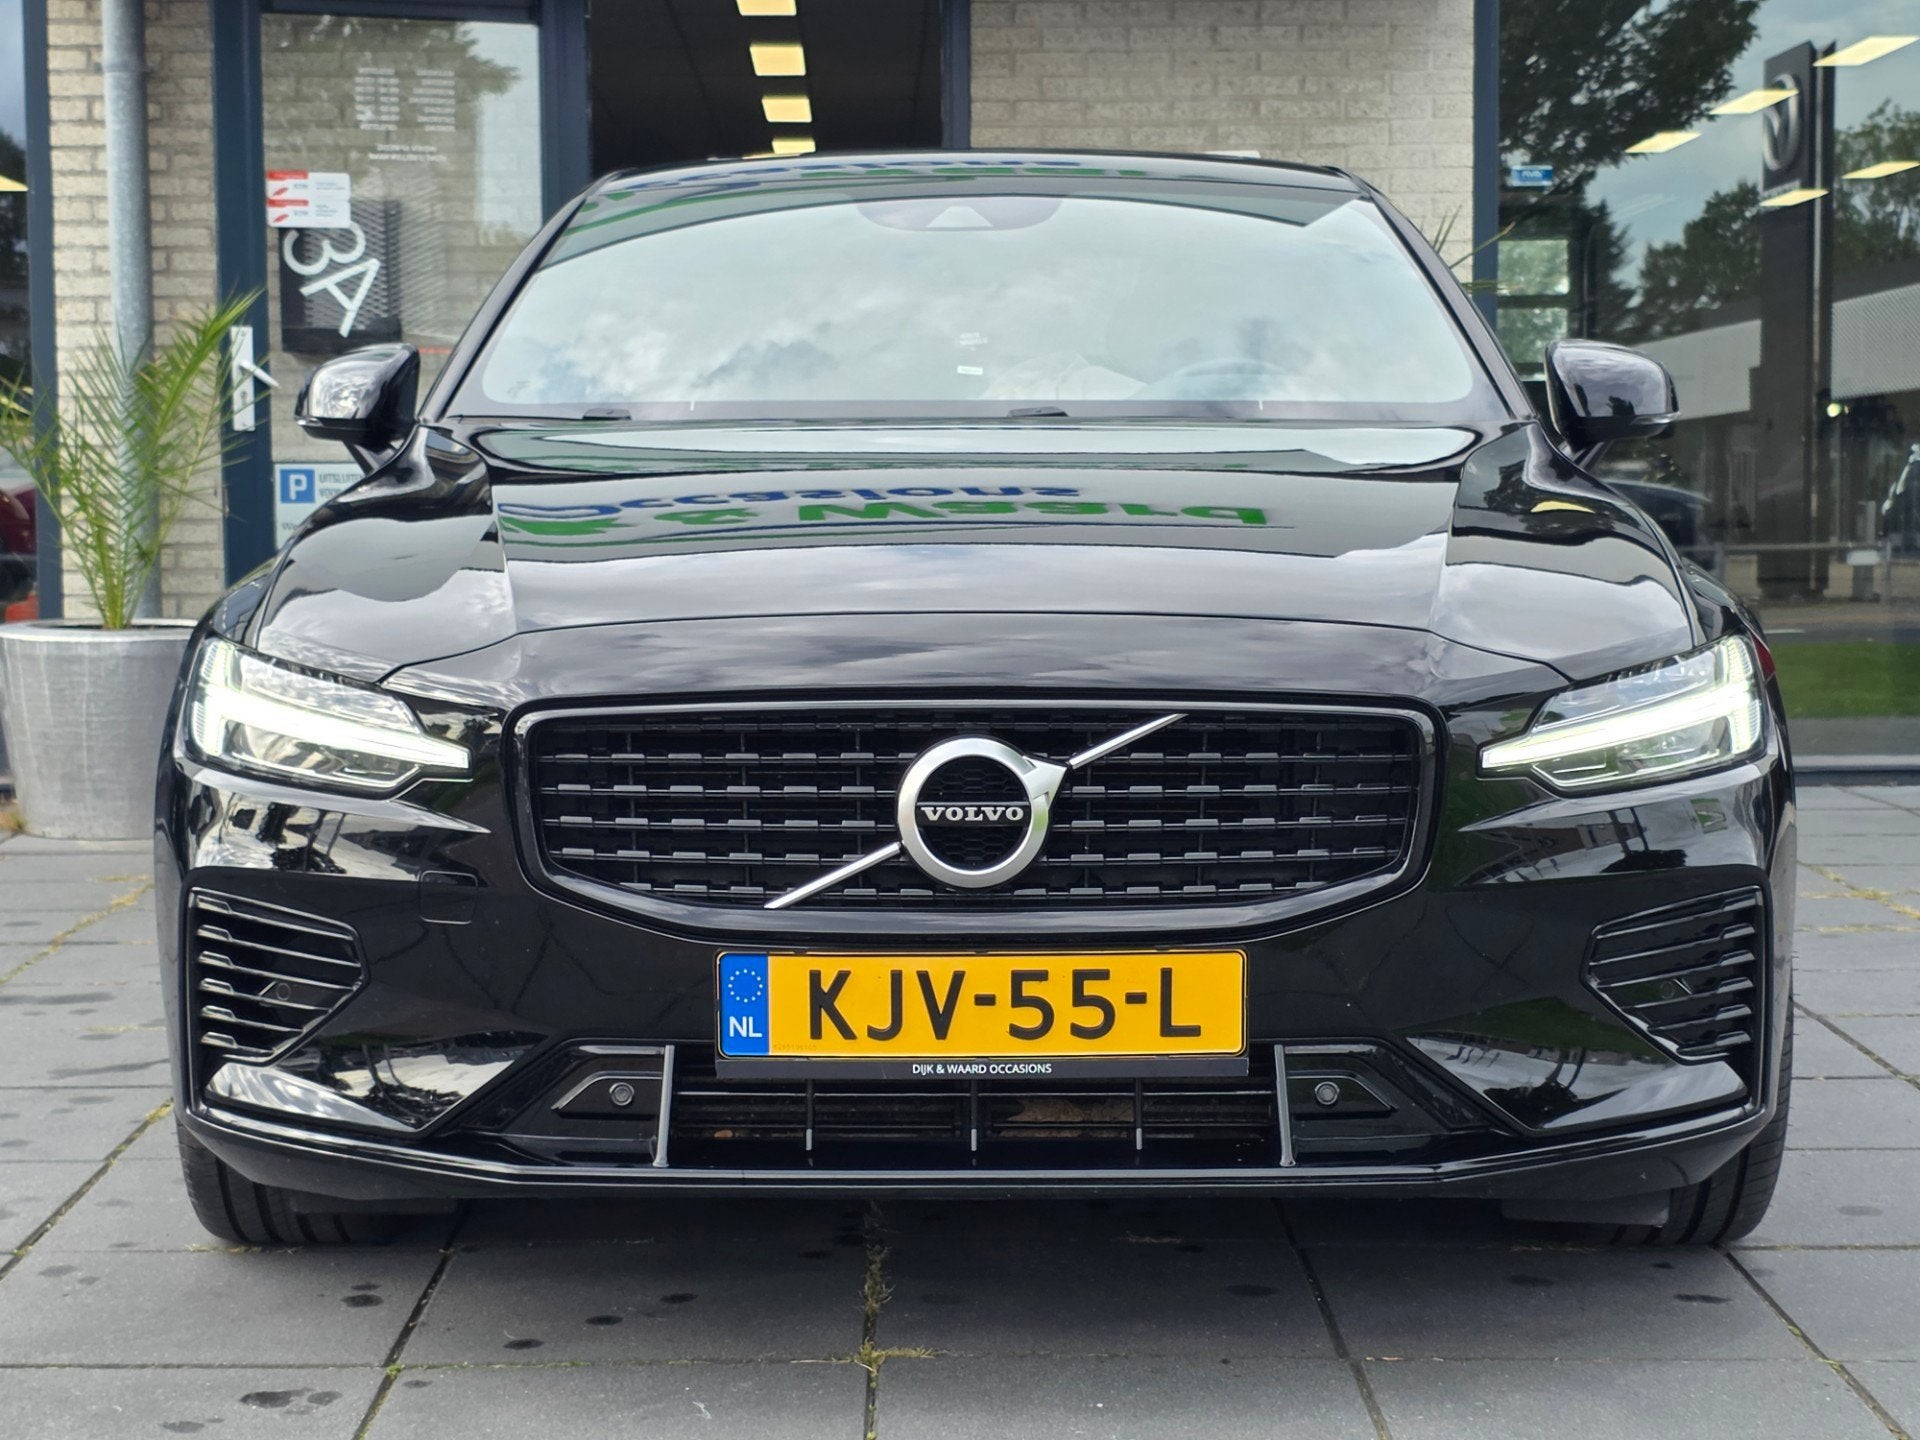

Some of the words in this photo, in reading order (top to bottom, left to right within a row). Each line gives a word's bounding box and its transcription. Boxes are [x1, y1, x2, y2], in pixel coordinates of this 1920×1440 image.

[289, 474, 307, 500] P
[920, 806, 1024, 821] VOLVO
[809, 967, 1202, 1041] KJV-55-L
[729, 1016, 763, 1037] NL
[912, 1063, 934, 1075] DIJK
[936, 1063, 945, 1074] &
[947, 1063, 987, 1074] WAARD
[989, 1063, 1052, 1074] OCCASIONS
